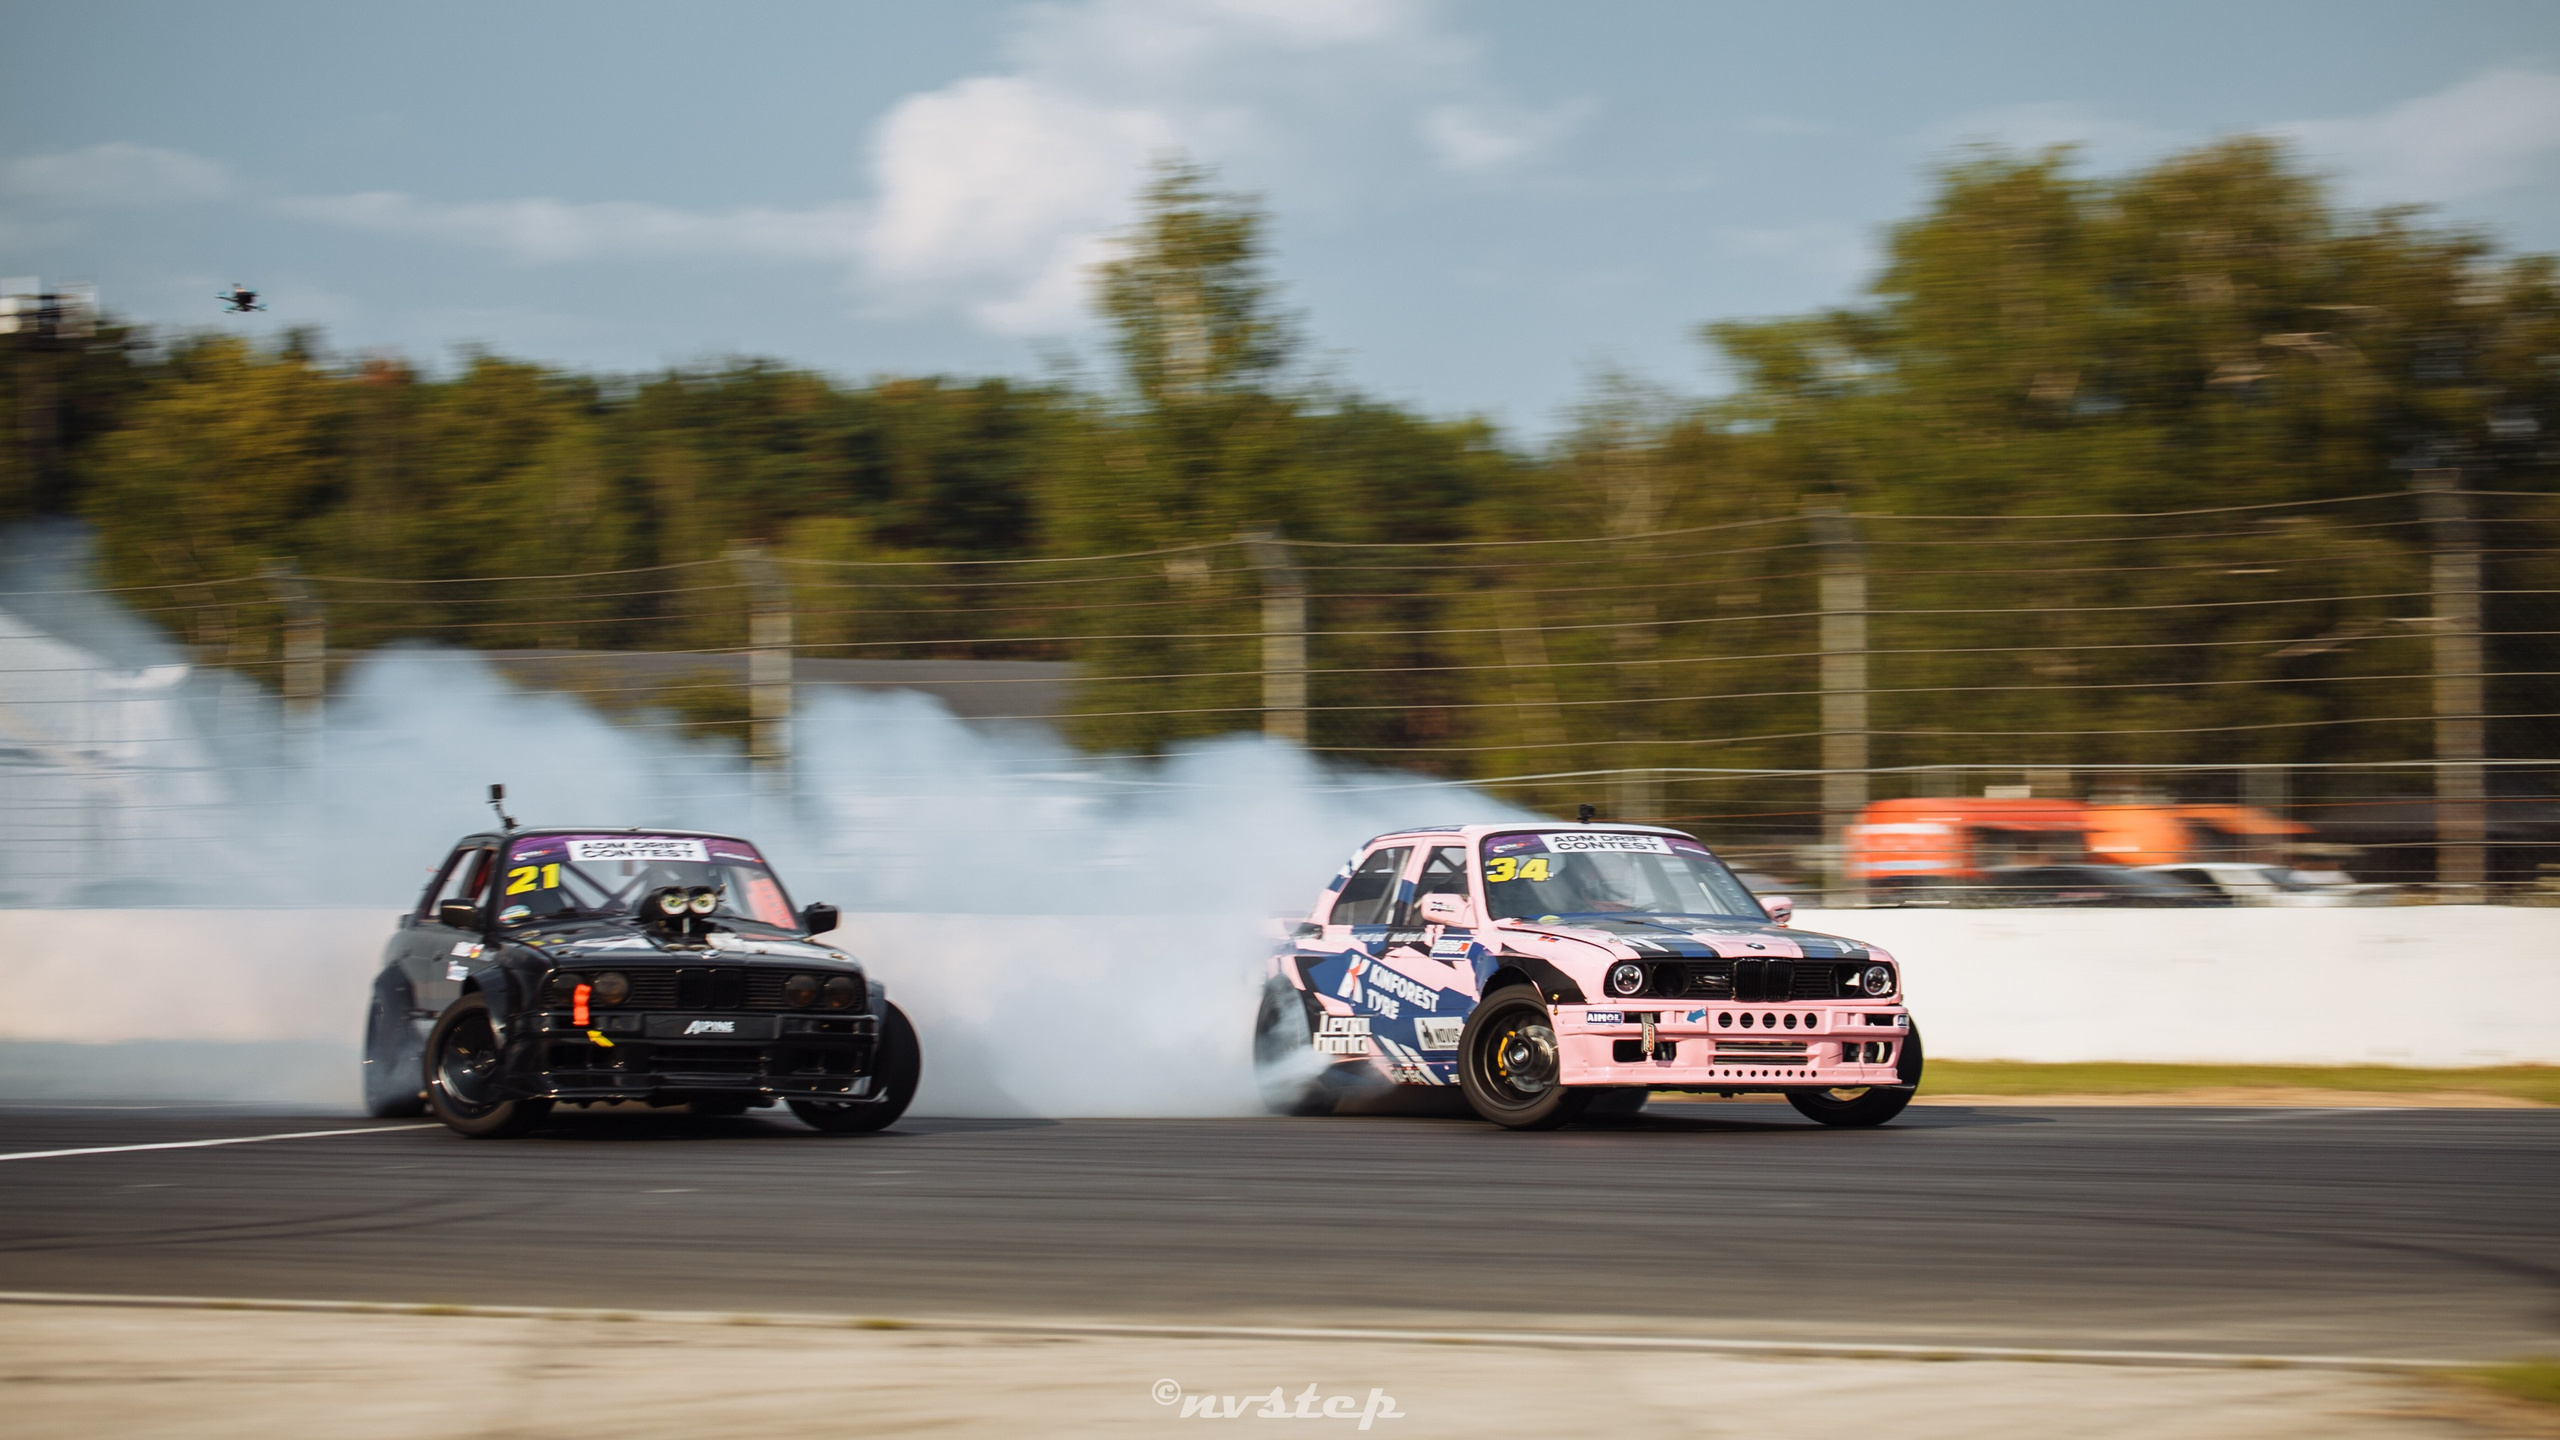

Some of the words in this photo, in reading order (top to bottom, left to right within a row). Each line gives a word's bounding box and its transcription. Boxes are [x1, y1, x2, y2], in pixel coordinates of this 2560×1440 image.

[1554, 835, 1595, 843] ADM
[1600, 835, 1653, 843] DRIFT
[1558, 842, 1658, 850] CONTEST
[582, 850, 695, 858] CONTEST
[1487, 857, 1550, 883] 34
[505, 863, 560, 896] 21
[1366, 988, 1400, 1020] TYRE
[1587, 1013, 1621, 1022] AIMOL
